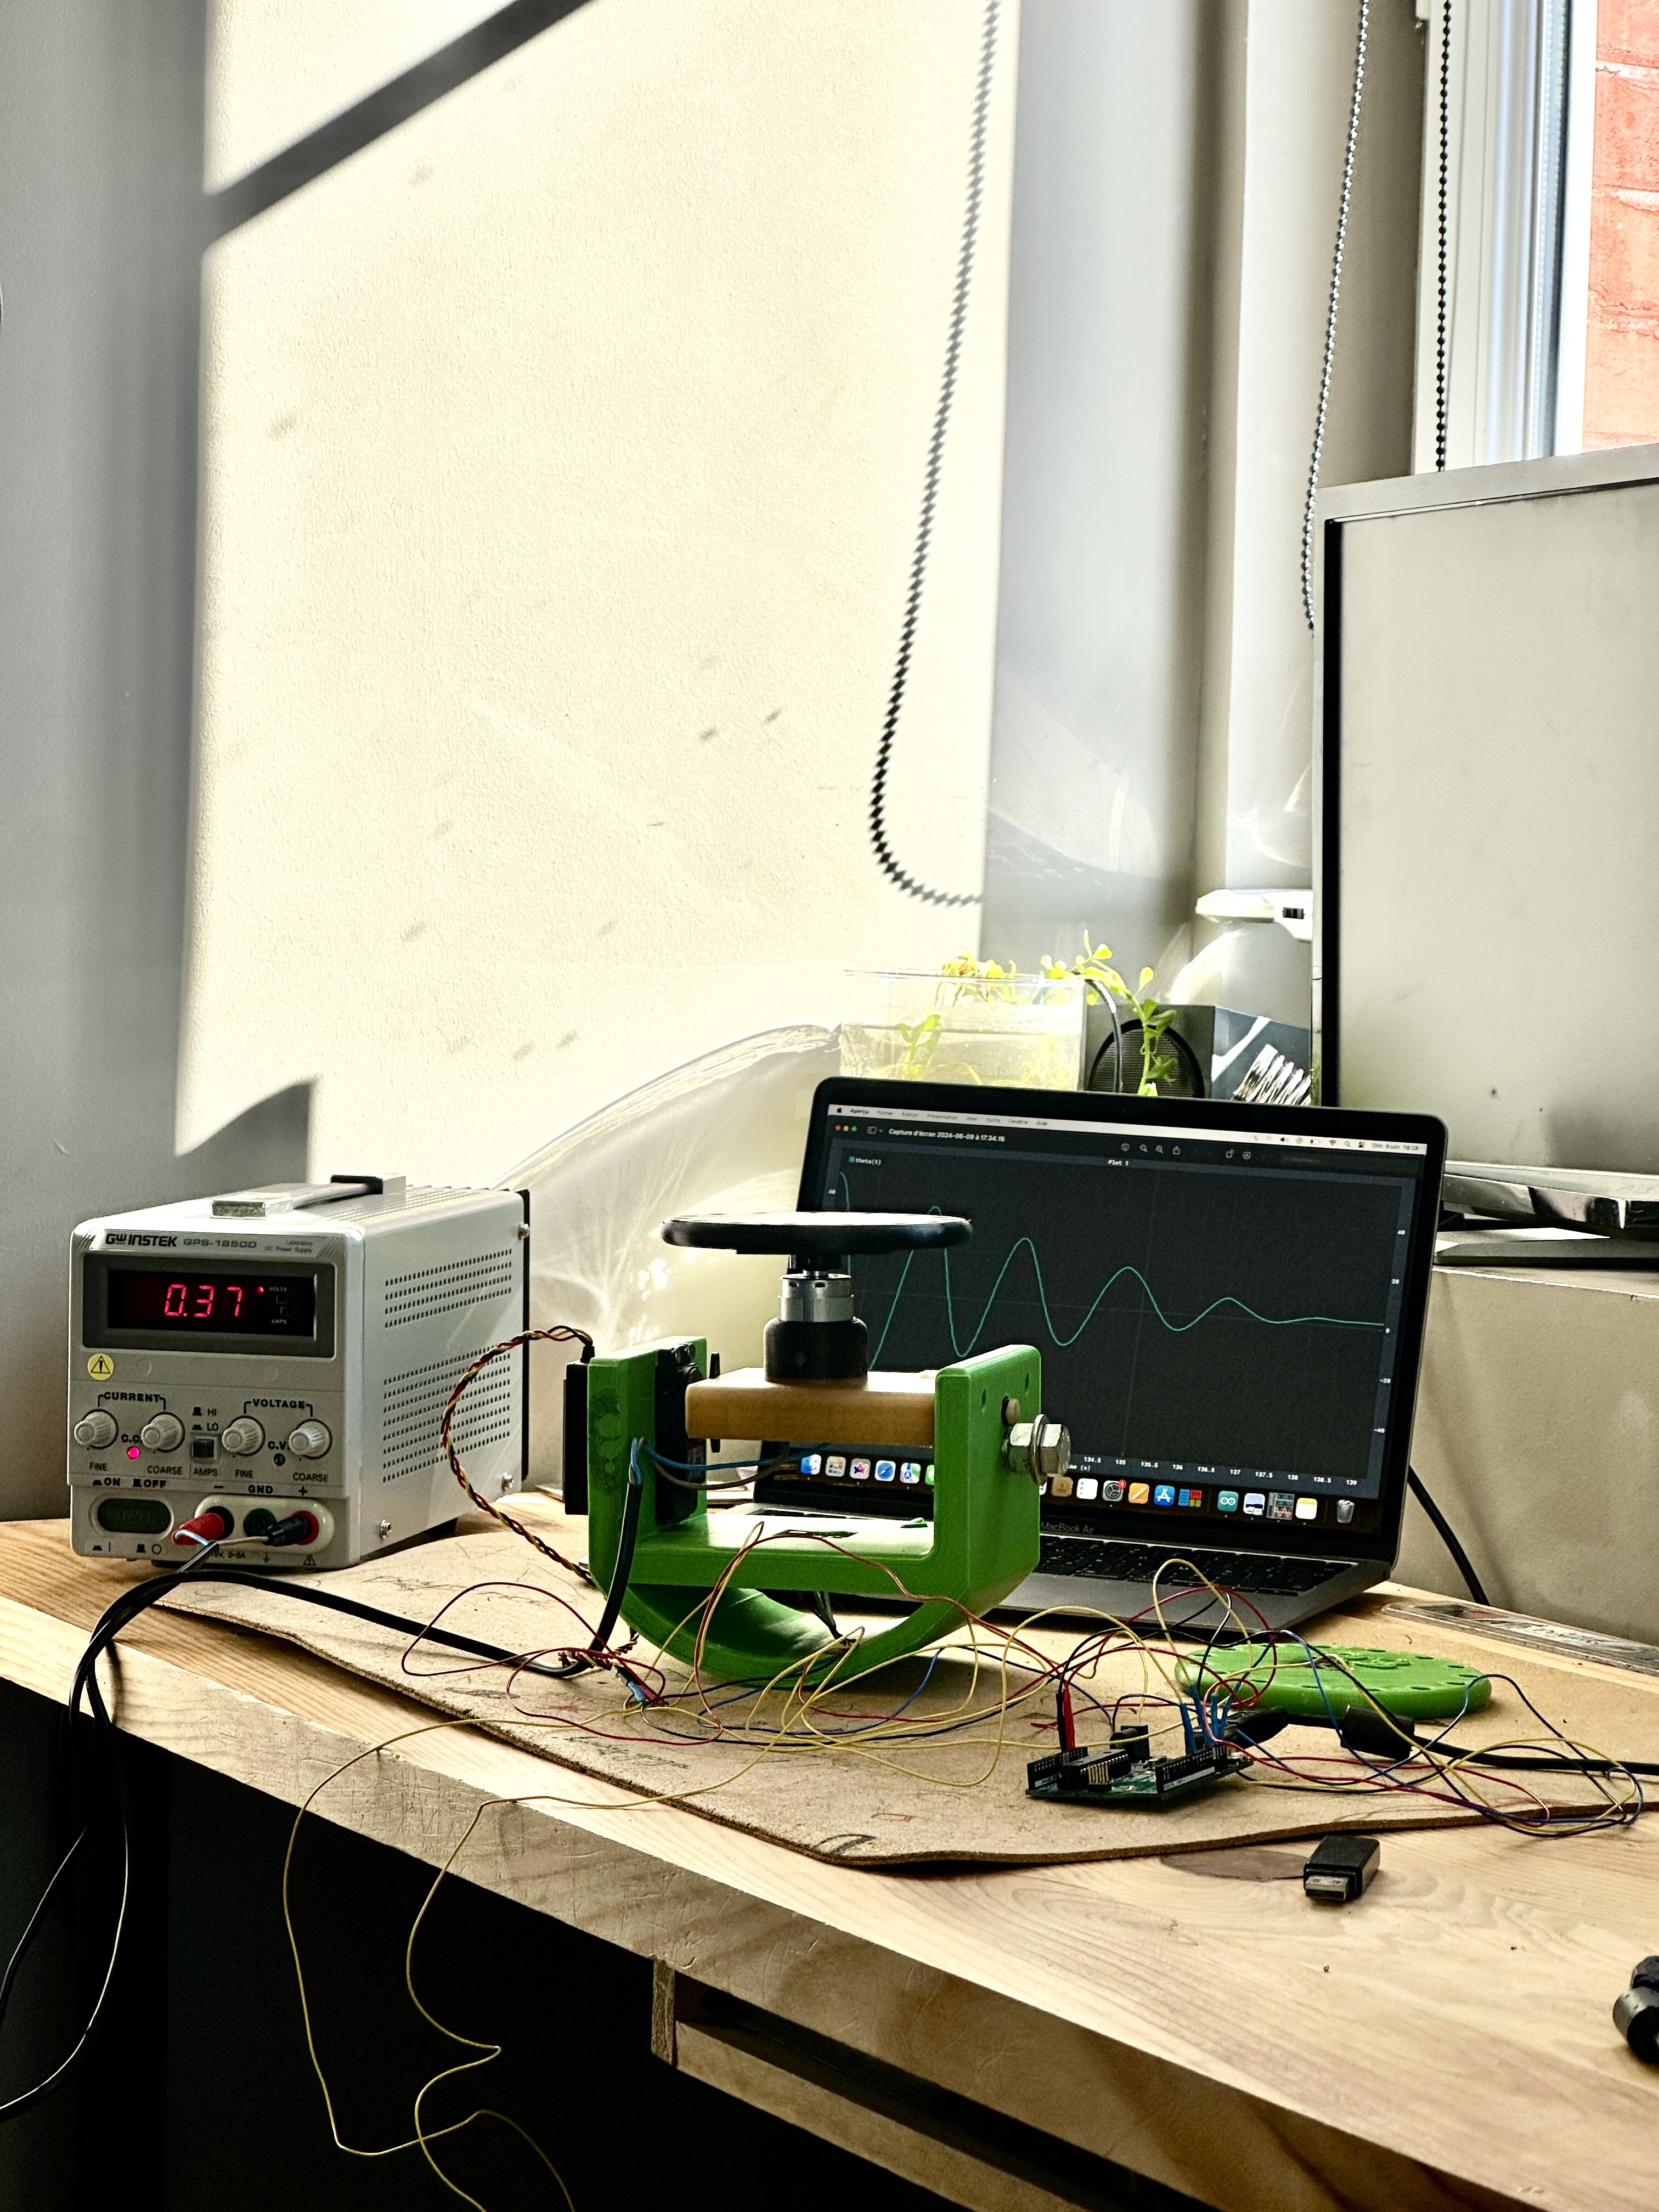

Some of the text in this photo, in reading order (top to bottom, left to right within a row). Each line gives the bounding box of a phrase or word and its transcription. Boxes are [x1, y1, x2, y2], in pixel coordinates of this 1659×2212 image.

[888, 1128, 912, 1136] Capture
[855, 1158, 882, 1166] theta(t)
[165, 1284, 242, 1317] 0.37
[104, 1391, 161, 1402] CURRENT
[253, 1398, 306, 1409] VOLTAGE
[207, 1423, 219, 1431] LO
[89, 1462, 107, 1471] FINE
[146, 1465, 183, 1475] COARSE
[193, 1468, 218, 1476] AMPS
[235, 1469, 253, 1479] FINE
[104, 1477, 121, 1486] ON
[292, 1472, 329, 1482] COARSE
[144, 1479, 167, 1488] OFF
[248, 1485, 273, 1494] GND
[1041, 1521, 1095, 1533] MacBook Air
